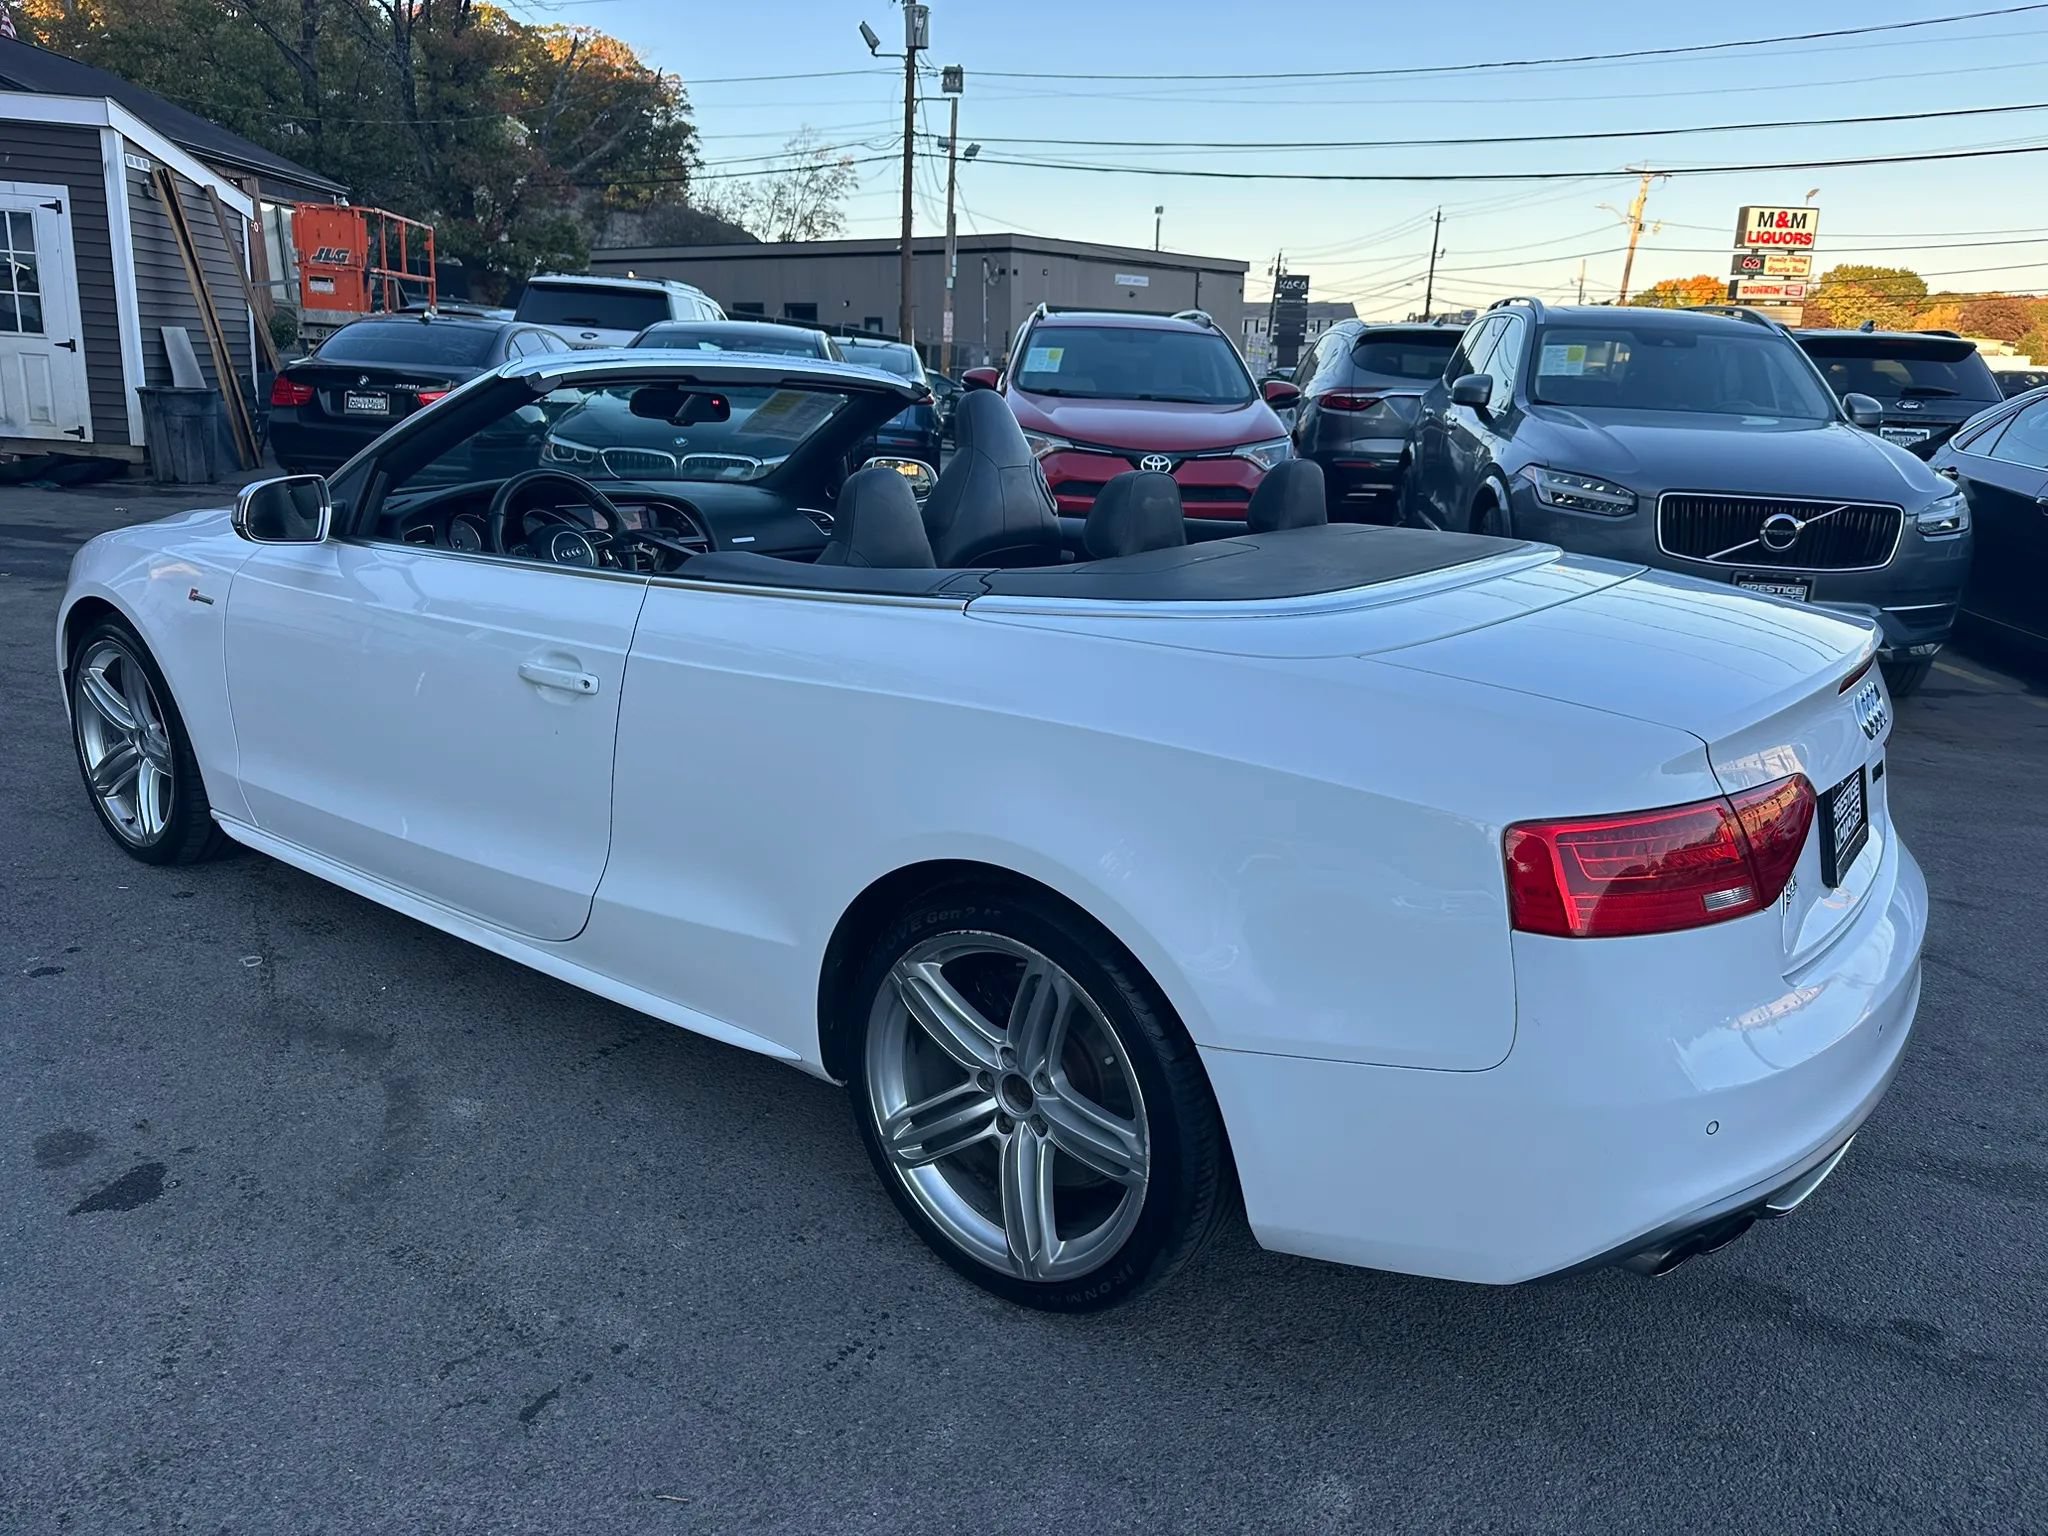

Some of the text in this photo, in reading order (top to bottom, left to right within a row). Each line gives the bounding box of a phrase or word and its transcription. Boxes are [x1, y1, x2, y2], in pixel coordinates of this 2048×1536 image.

[1757, 211, 1808, 229] M&M
[1747, 231, 1812, 245] LIQUORS
[310, 247, 350, 264] JLG
[1741, 583, 1805, 595] PRESTIGE
